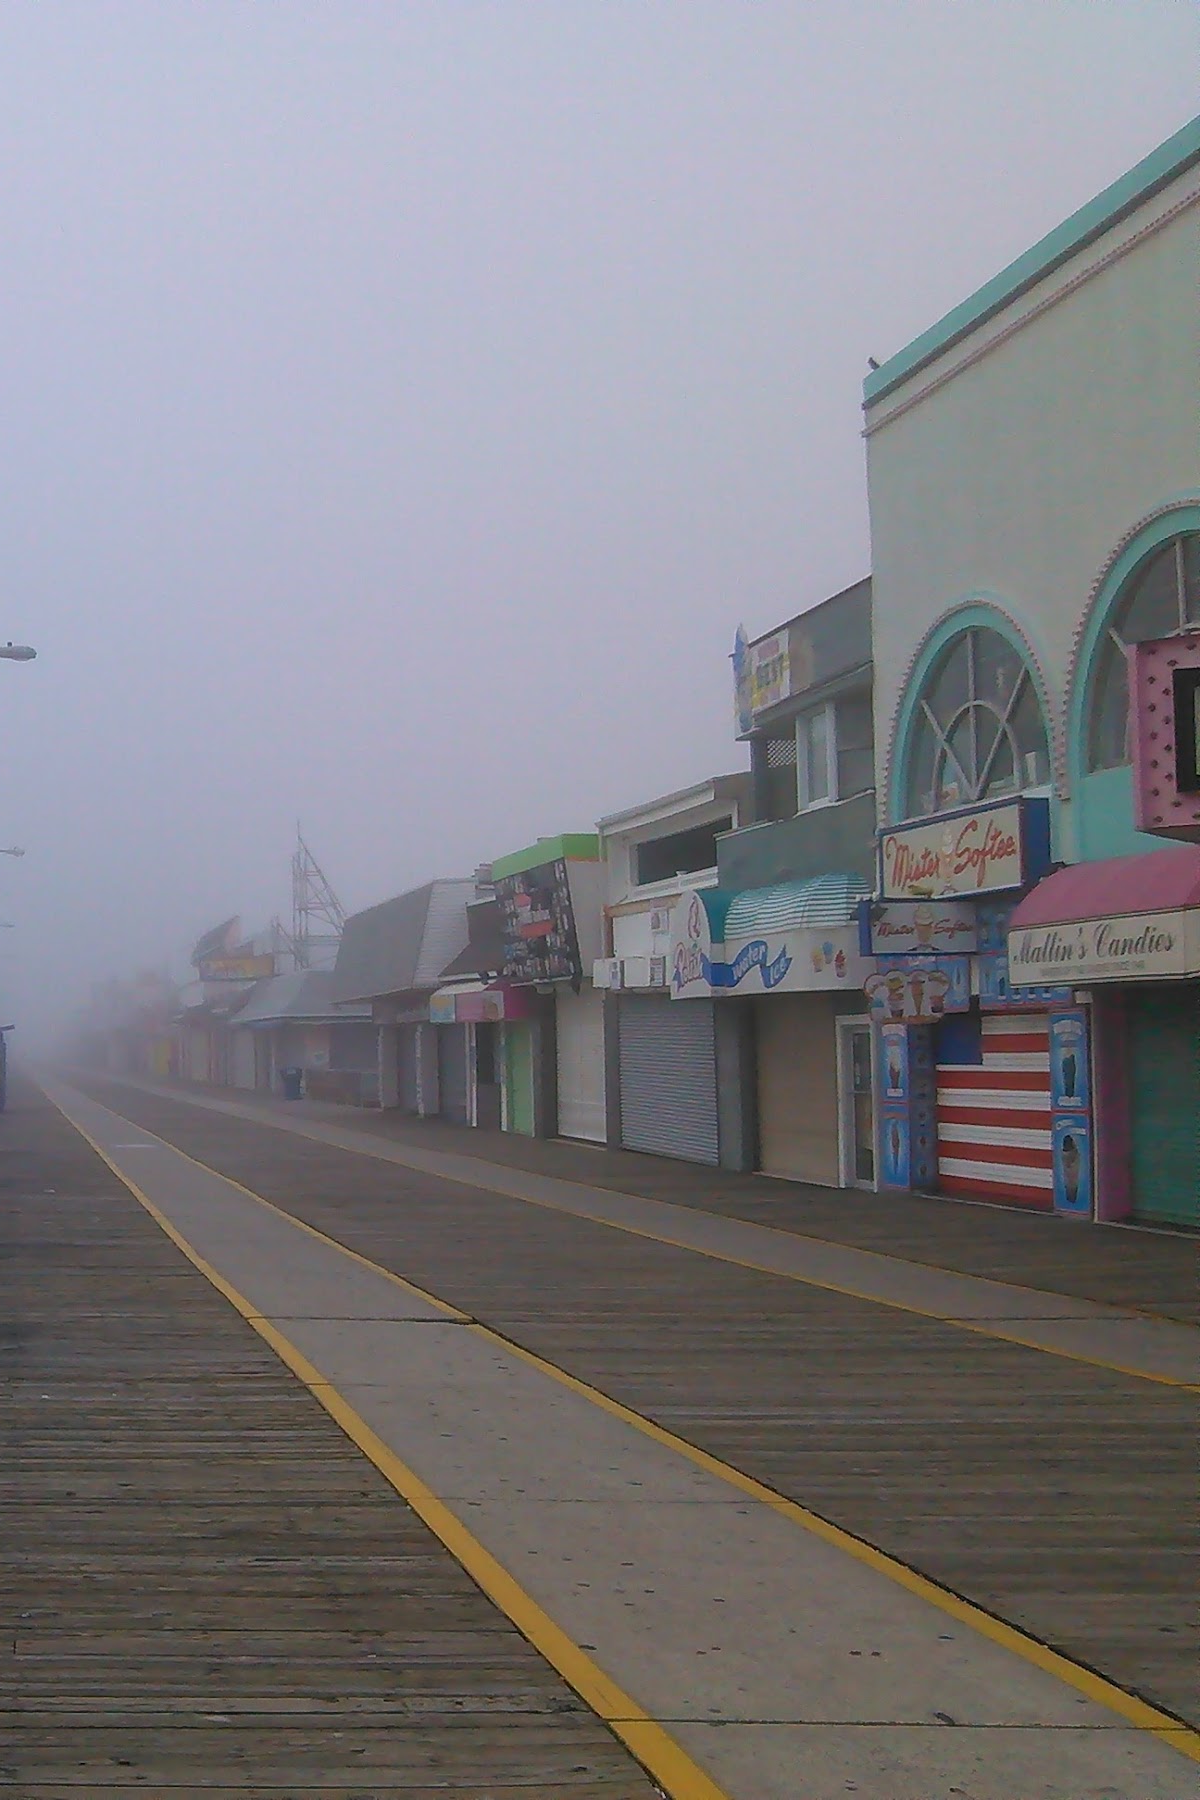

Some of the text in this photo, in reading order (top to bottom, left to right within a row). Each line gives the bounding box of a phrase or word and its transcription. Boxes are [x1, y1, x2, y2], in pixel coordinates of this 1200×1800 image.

[885, 819, 1017, 890] Mister Softee
[1093, 924, 1174, 958] Candies
